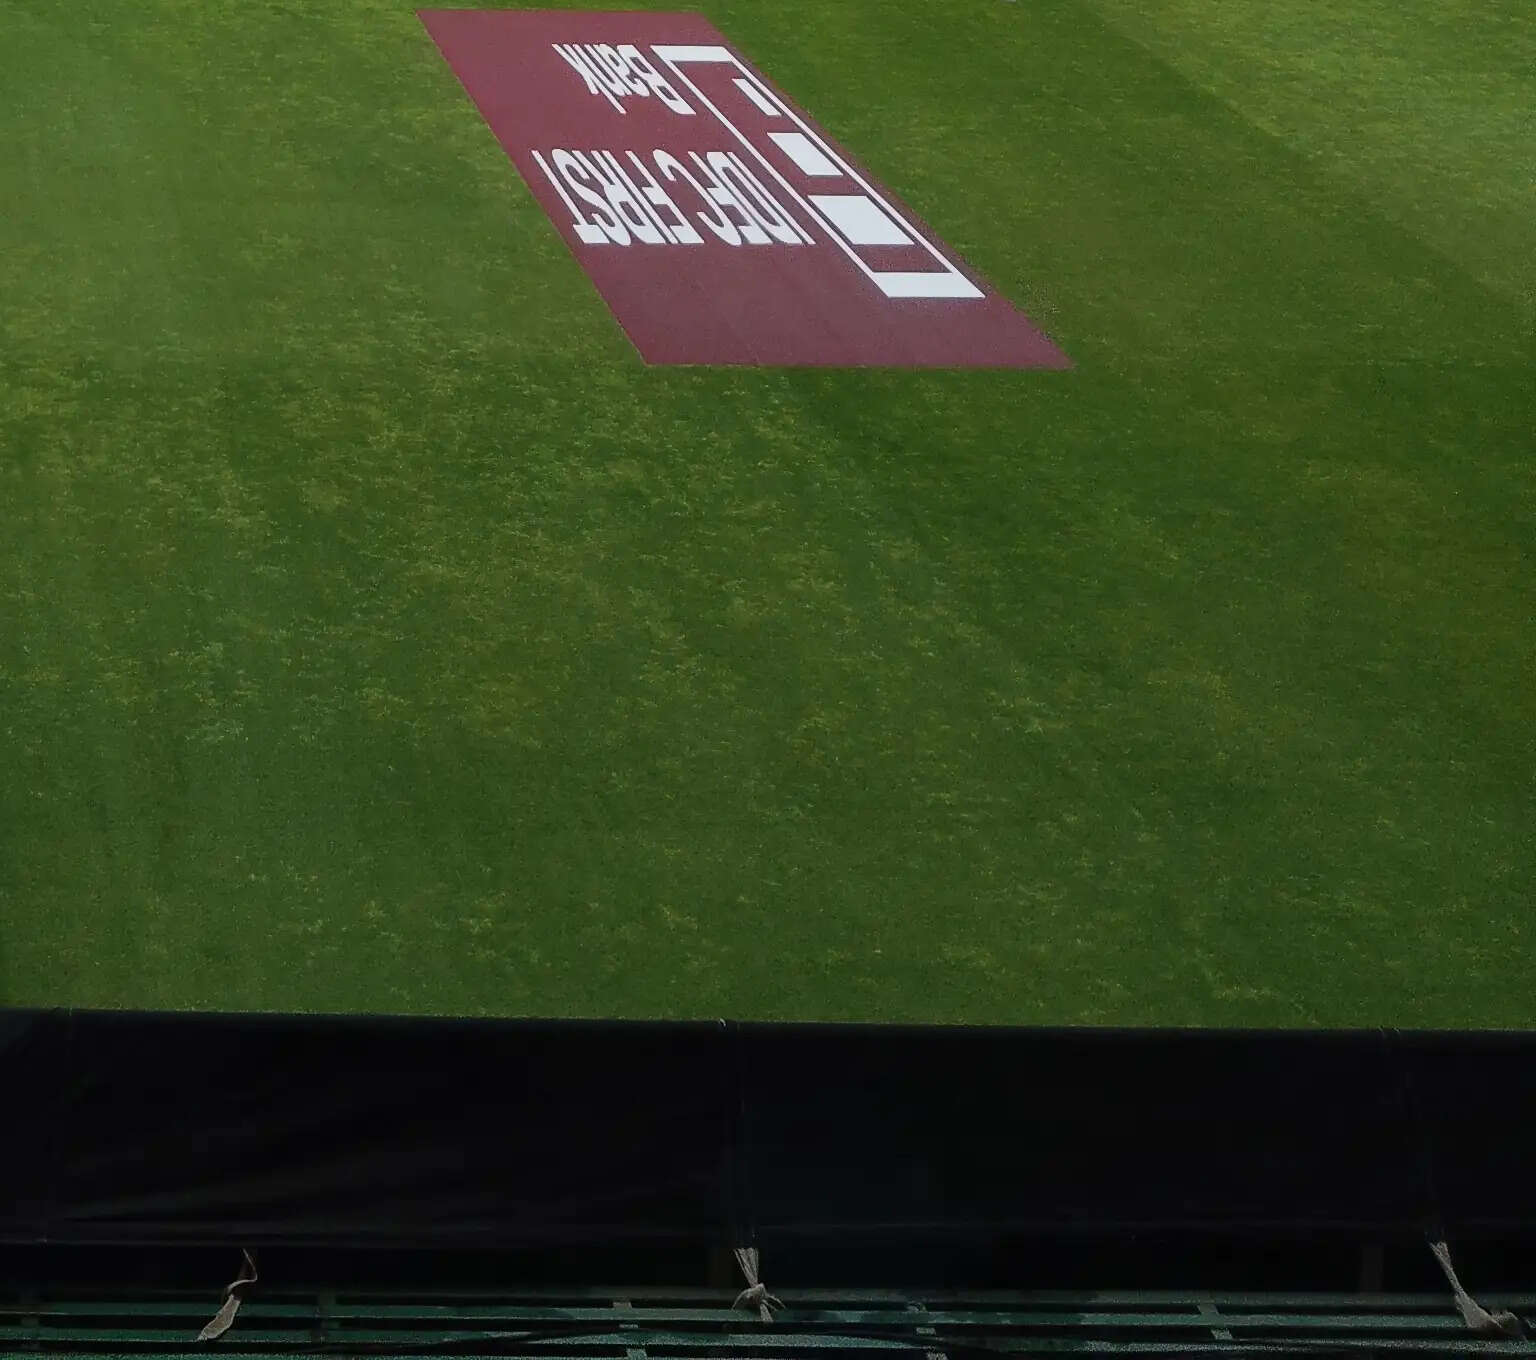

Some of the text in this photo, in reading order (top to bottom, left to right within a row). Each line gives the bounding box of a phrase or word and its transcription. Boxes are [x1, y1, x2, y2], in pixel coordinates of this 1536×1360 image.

[551, 43, 697, 115] Bank
[532, 149, 816, 246] IDFC FIRST
